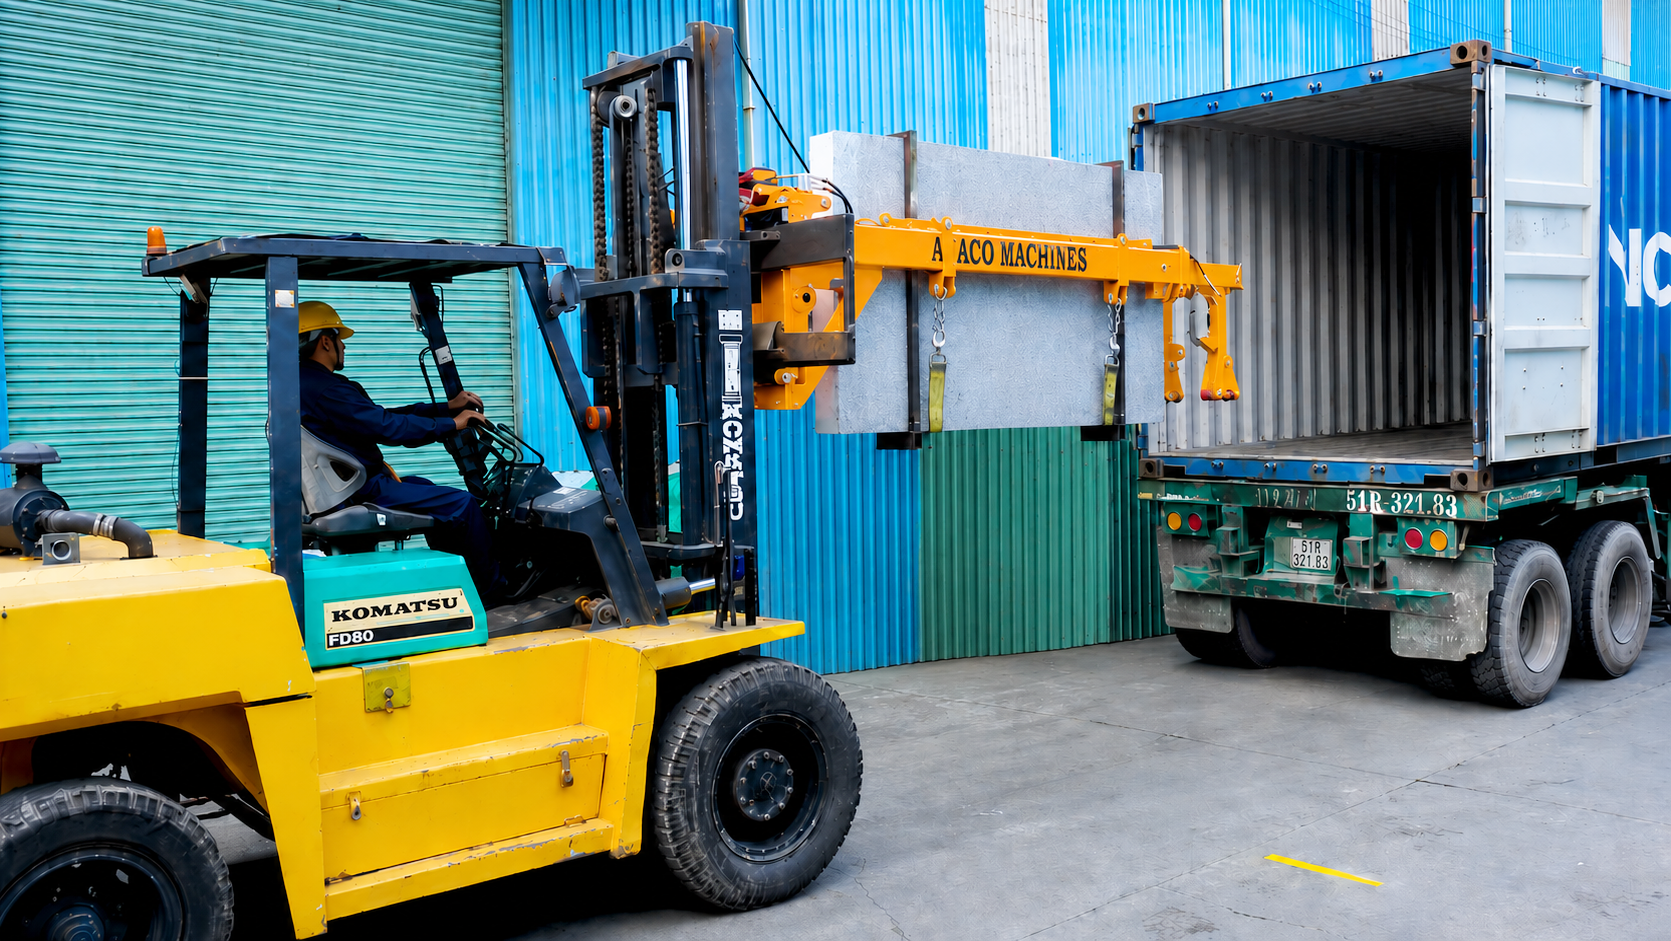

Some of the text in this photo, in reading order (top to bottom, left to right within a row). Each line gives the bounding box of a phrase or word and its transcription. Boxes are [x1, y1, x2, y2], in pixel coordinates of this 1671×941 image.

[931, 236, 1087, 272] AACO MACHINES
[1346, 489, 1458, 519] 51R-321.83
[1293, 553, 1329, 569] 321.83
[331, 596, 458, 623] KOMATSU
[328, 629, 374, 647] FD80
